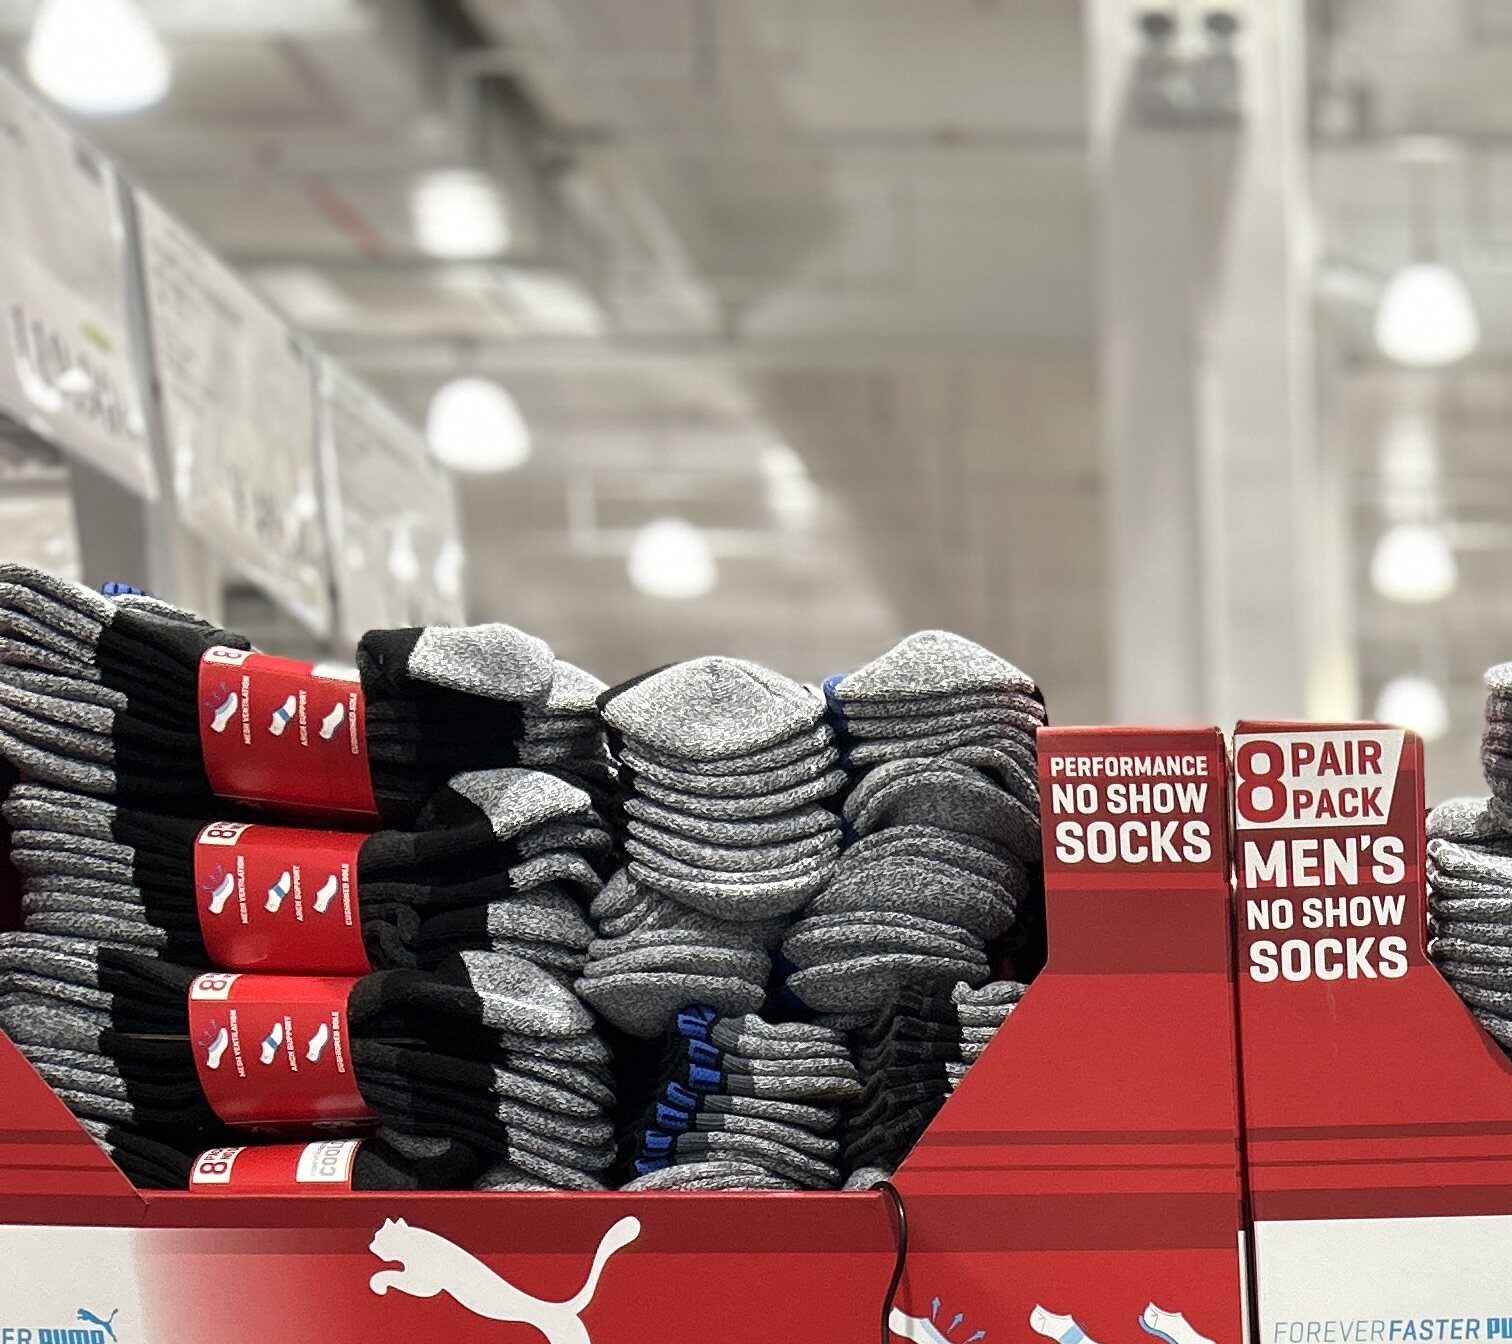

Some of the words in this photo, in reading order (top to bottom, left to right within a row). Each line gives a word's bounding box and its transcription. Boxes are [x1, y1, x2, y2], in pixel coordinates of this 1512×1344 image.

[1050, 755, 1208, 777] PERFORMANCE
[1237, 740, 1288, 823] 8
[1291, 740, 1382, 777] PAIR
[1052, 783, 1099, 814] NO
[1107, 782, 1208, 814] SHOW
[1292, 786, 1384, 820] PACK
[1055, 820, 1212, 864] SOCKS
[1243, 834, 1405, 889] MEN'S
[1247, 898, 1294, 931] NO
[1302, 895, 1406, 929] SHOW
[1249, 936, 1408, 982] SOCKS
[200, 1162, 227, 1175] 8
